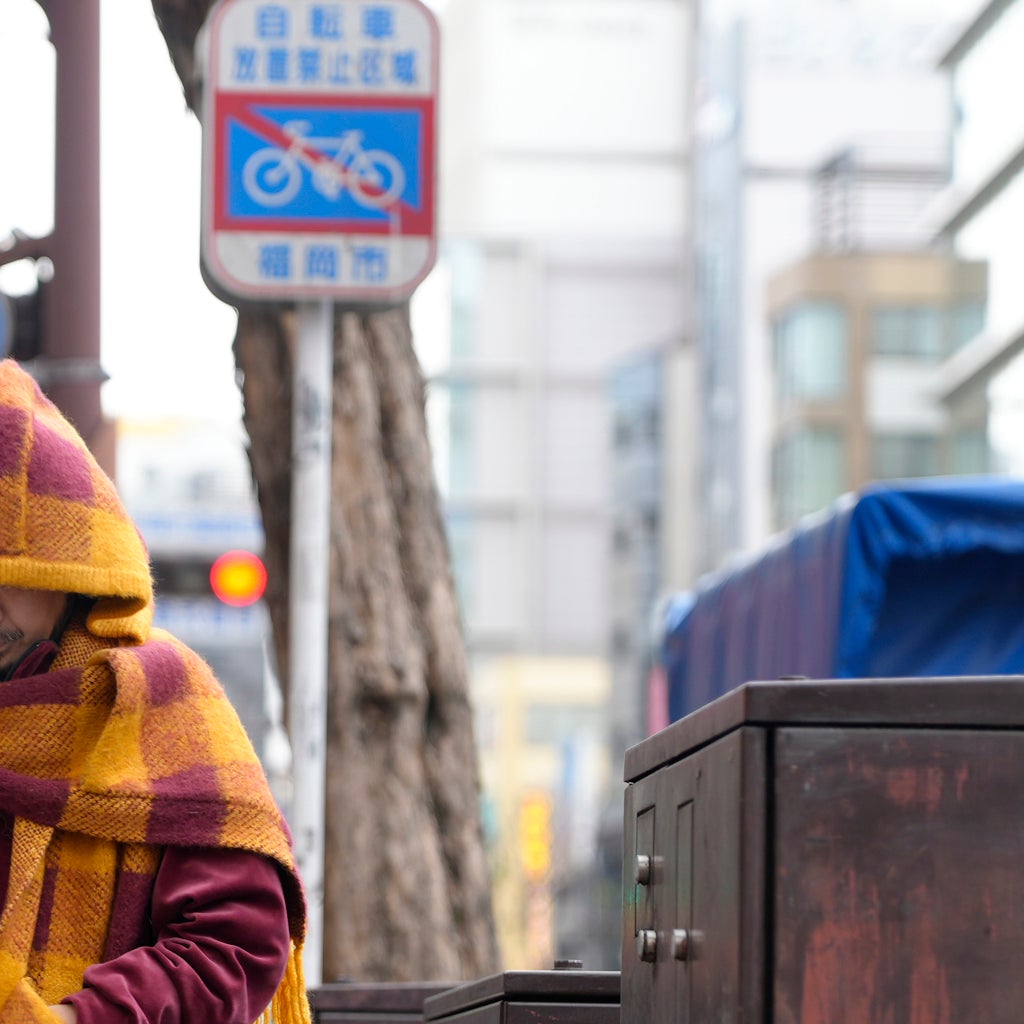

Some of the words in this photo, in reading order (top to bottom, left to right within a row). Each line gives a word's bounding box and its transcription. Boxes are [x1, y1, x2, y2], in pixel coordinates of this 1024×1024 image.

[257, 4, 394, 39] 自転車
[234, 46, 417, 84] 放置禁止区域
[258, 244, 387, 280] 福岡市
